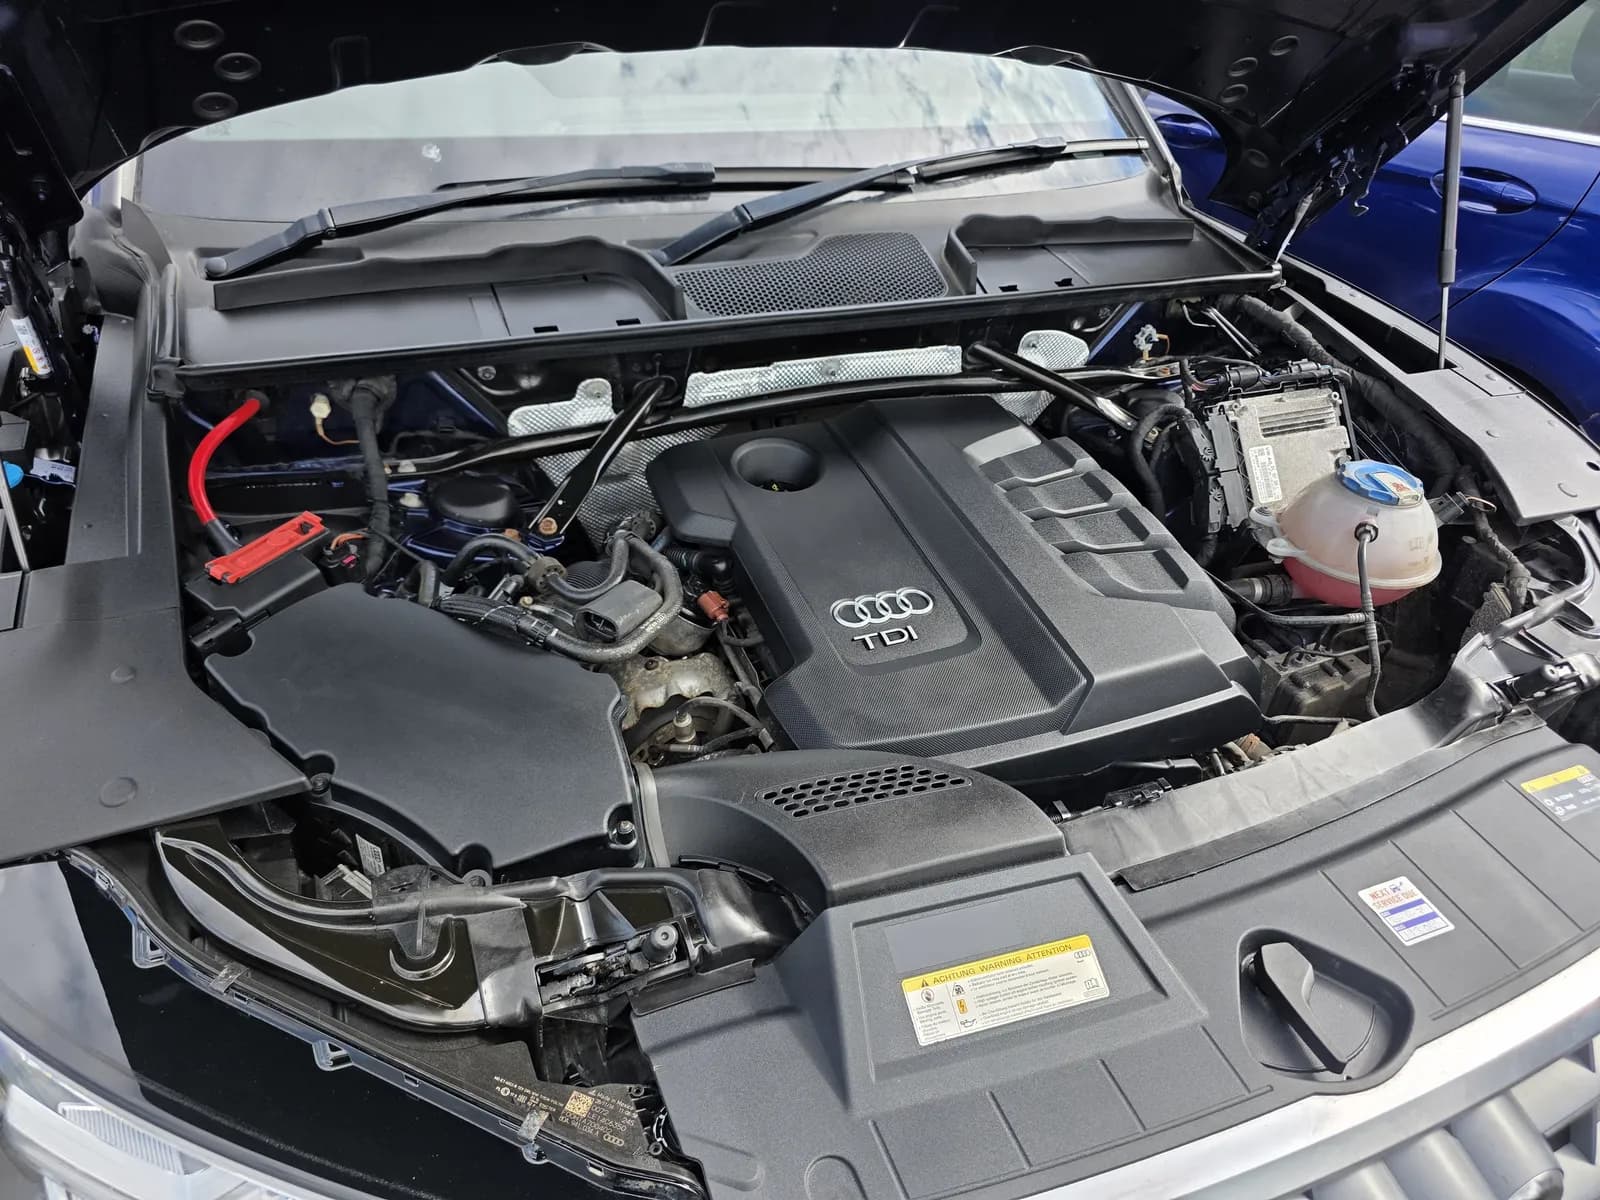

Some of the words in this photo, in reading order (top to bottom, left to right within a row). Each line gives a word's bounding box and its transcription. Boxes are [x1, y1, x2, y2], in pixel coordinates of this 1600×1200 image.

[852, 625, 918, 650] TDI
[1369, 888, 1391, 900] NEXT
[1372, 894, 1404, 909] SERVICE
[1401, 889, 1419, 900] DUE
[933, 967, 976, 985] ACHTUNG
[979, 956, 1022, 972] WARNING
[1026, 943, 1072, 961] ATTENTION
